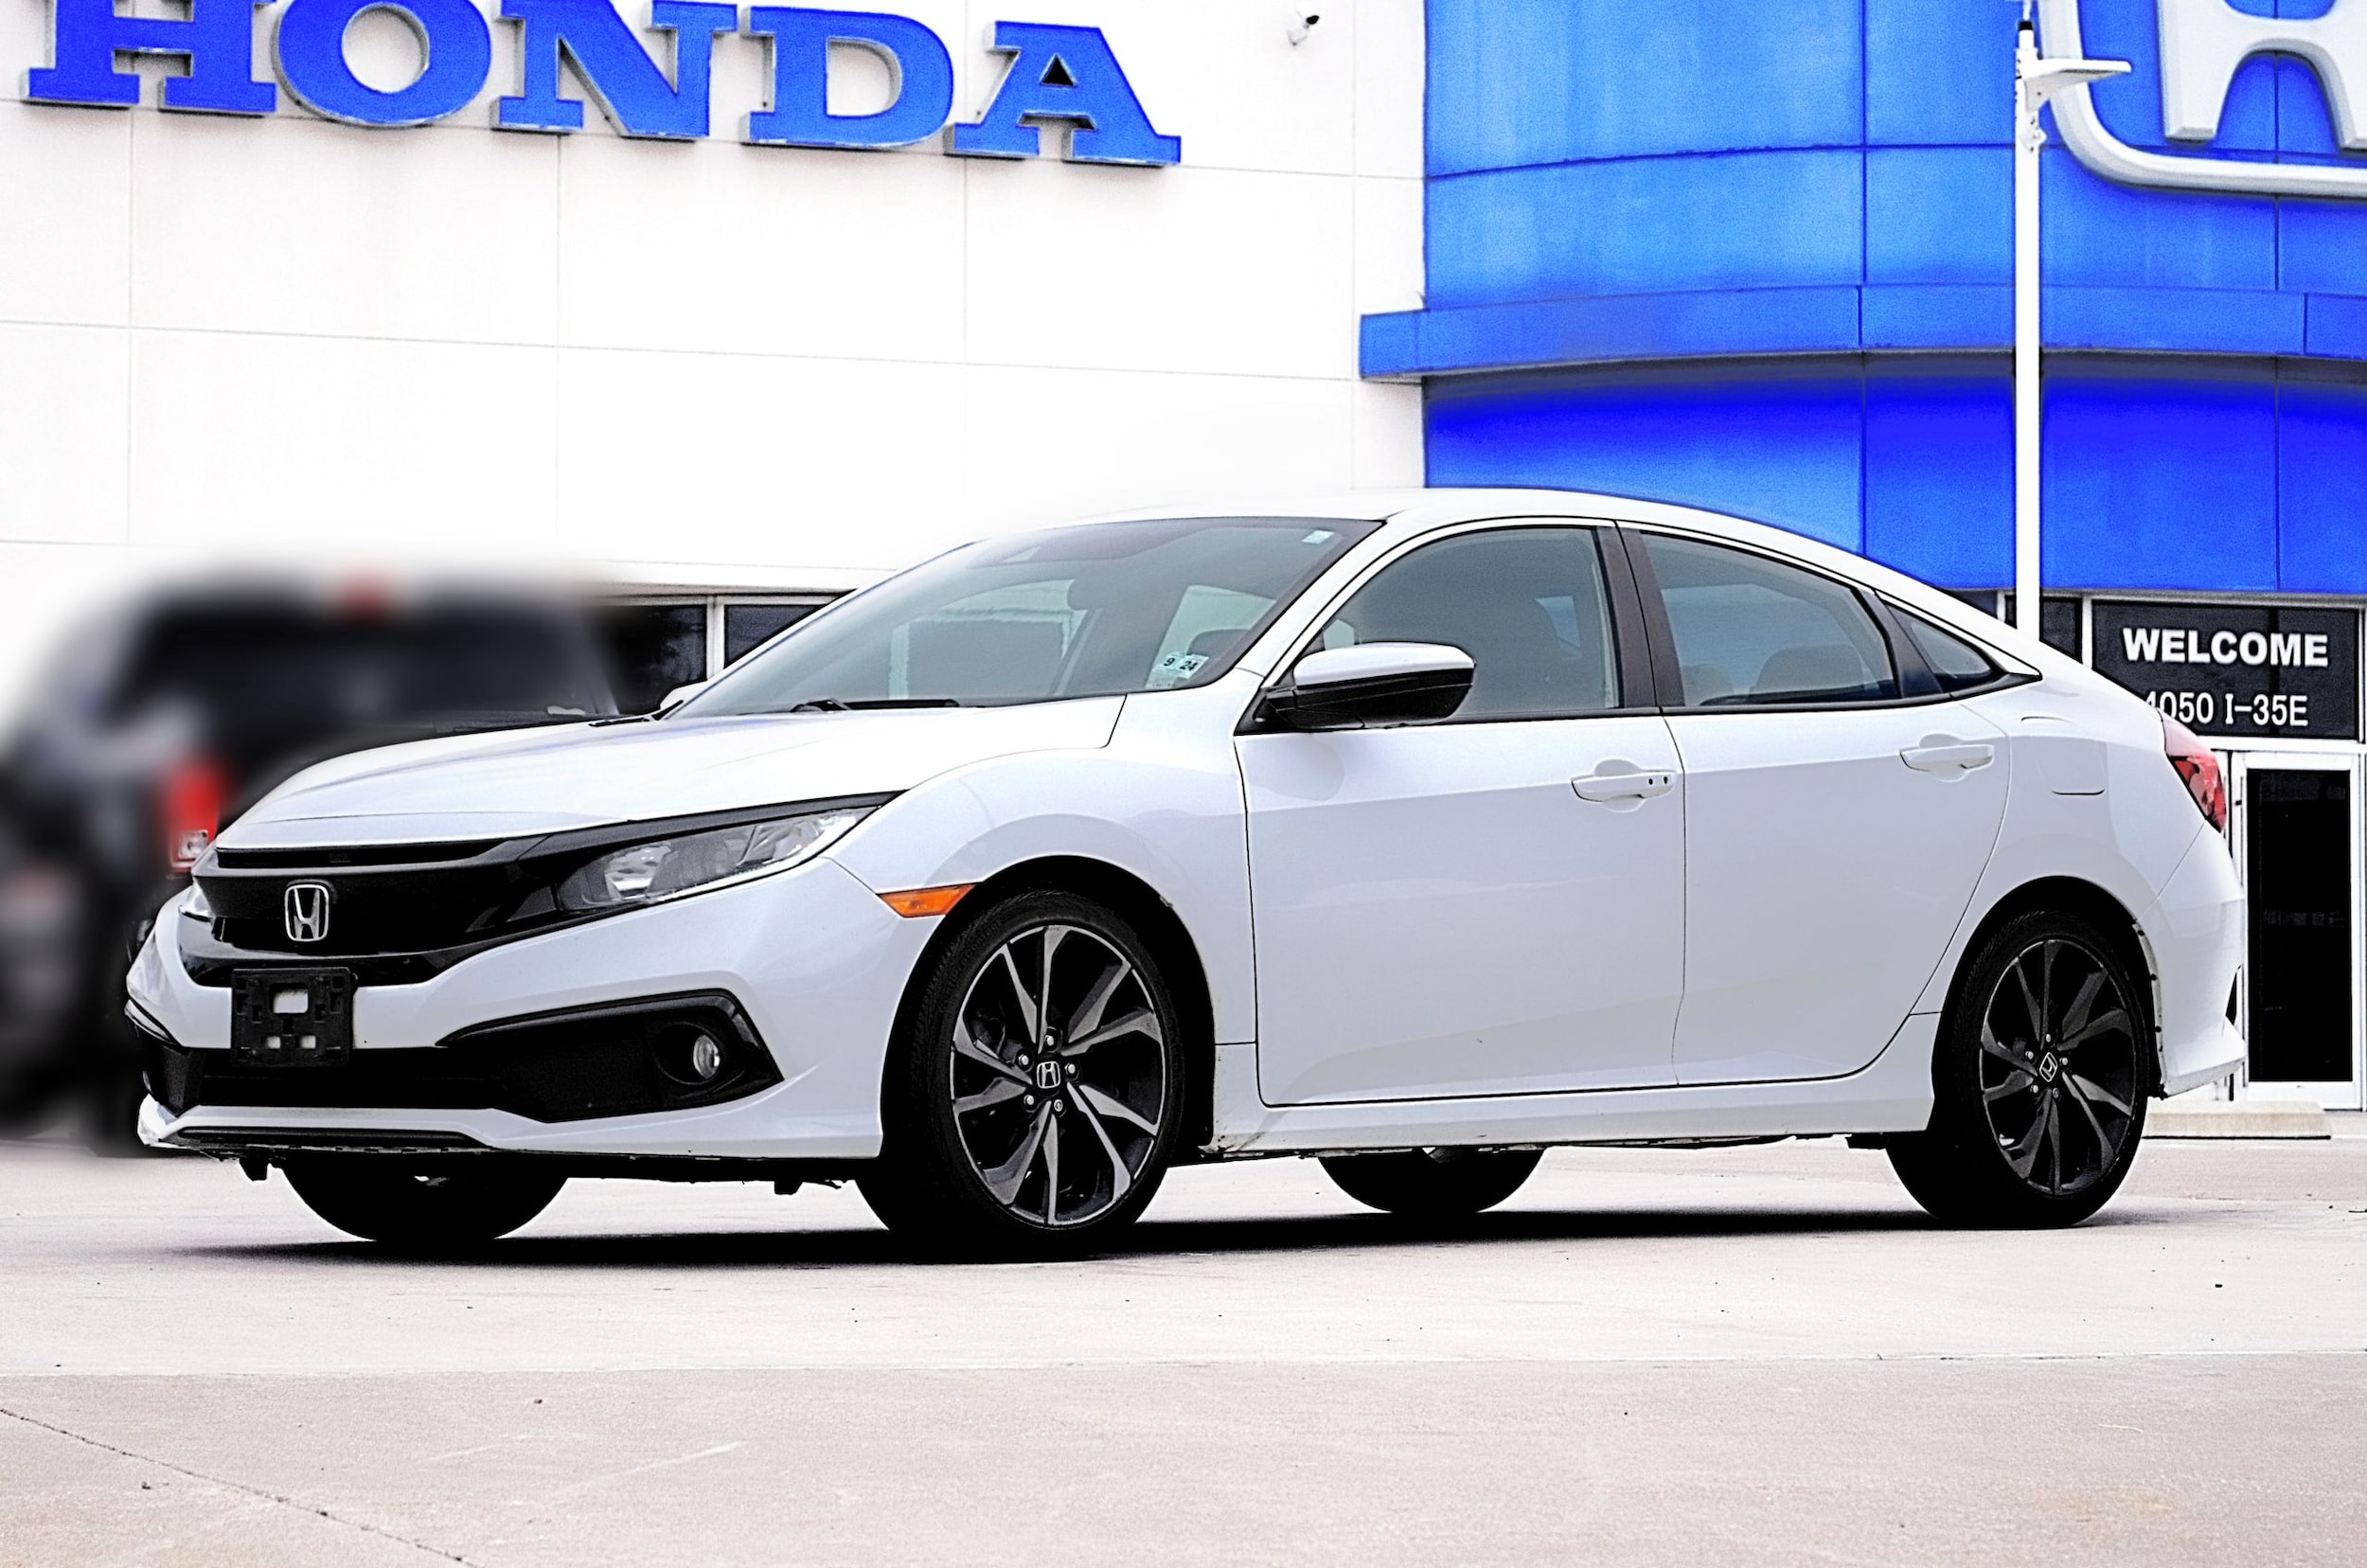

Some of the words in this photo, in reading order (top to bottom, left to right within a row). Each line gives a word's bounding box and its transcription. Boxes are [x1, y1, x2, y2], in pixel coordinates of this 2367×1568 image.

[20, 0, 1182, 166] HONDA
[1164, 657, 1176, 667] 9
[1179, 660, 1199, 671] 24
[2122, 627, 2329, 668] WELCOME
[2225, 693, 2308, 726] I-35E
